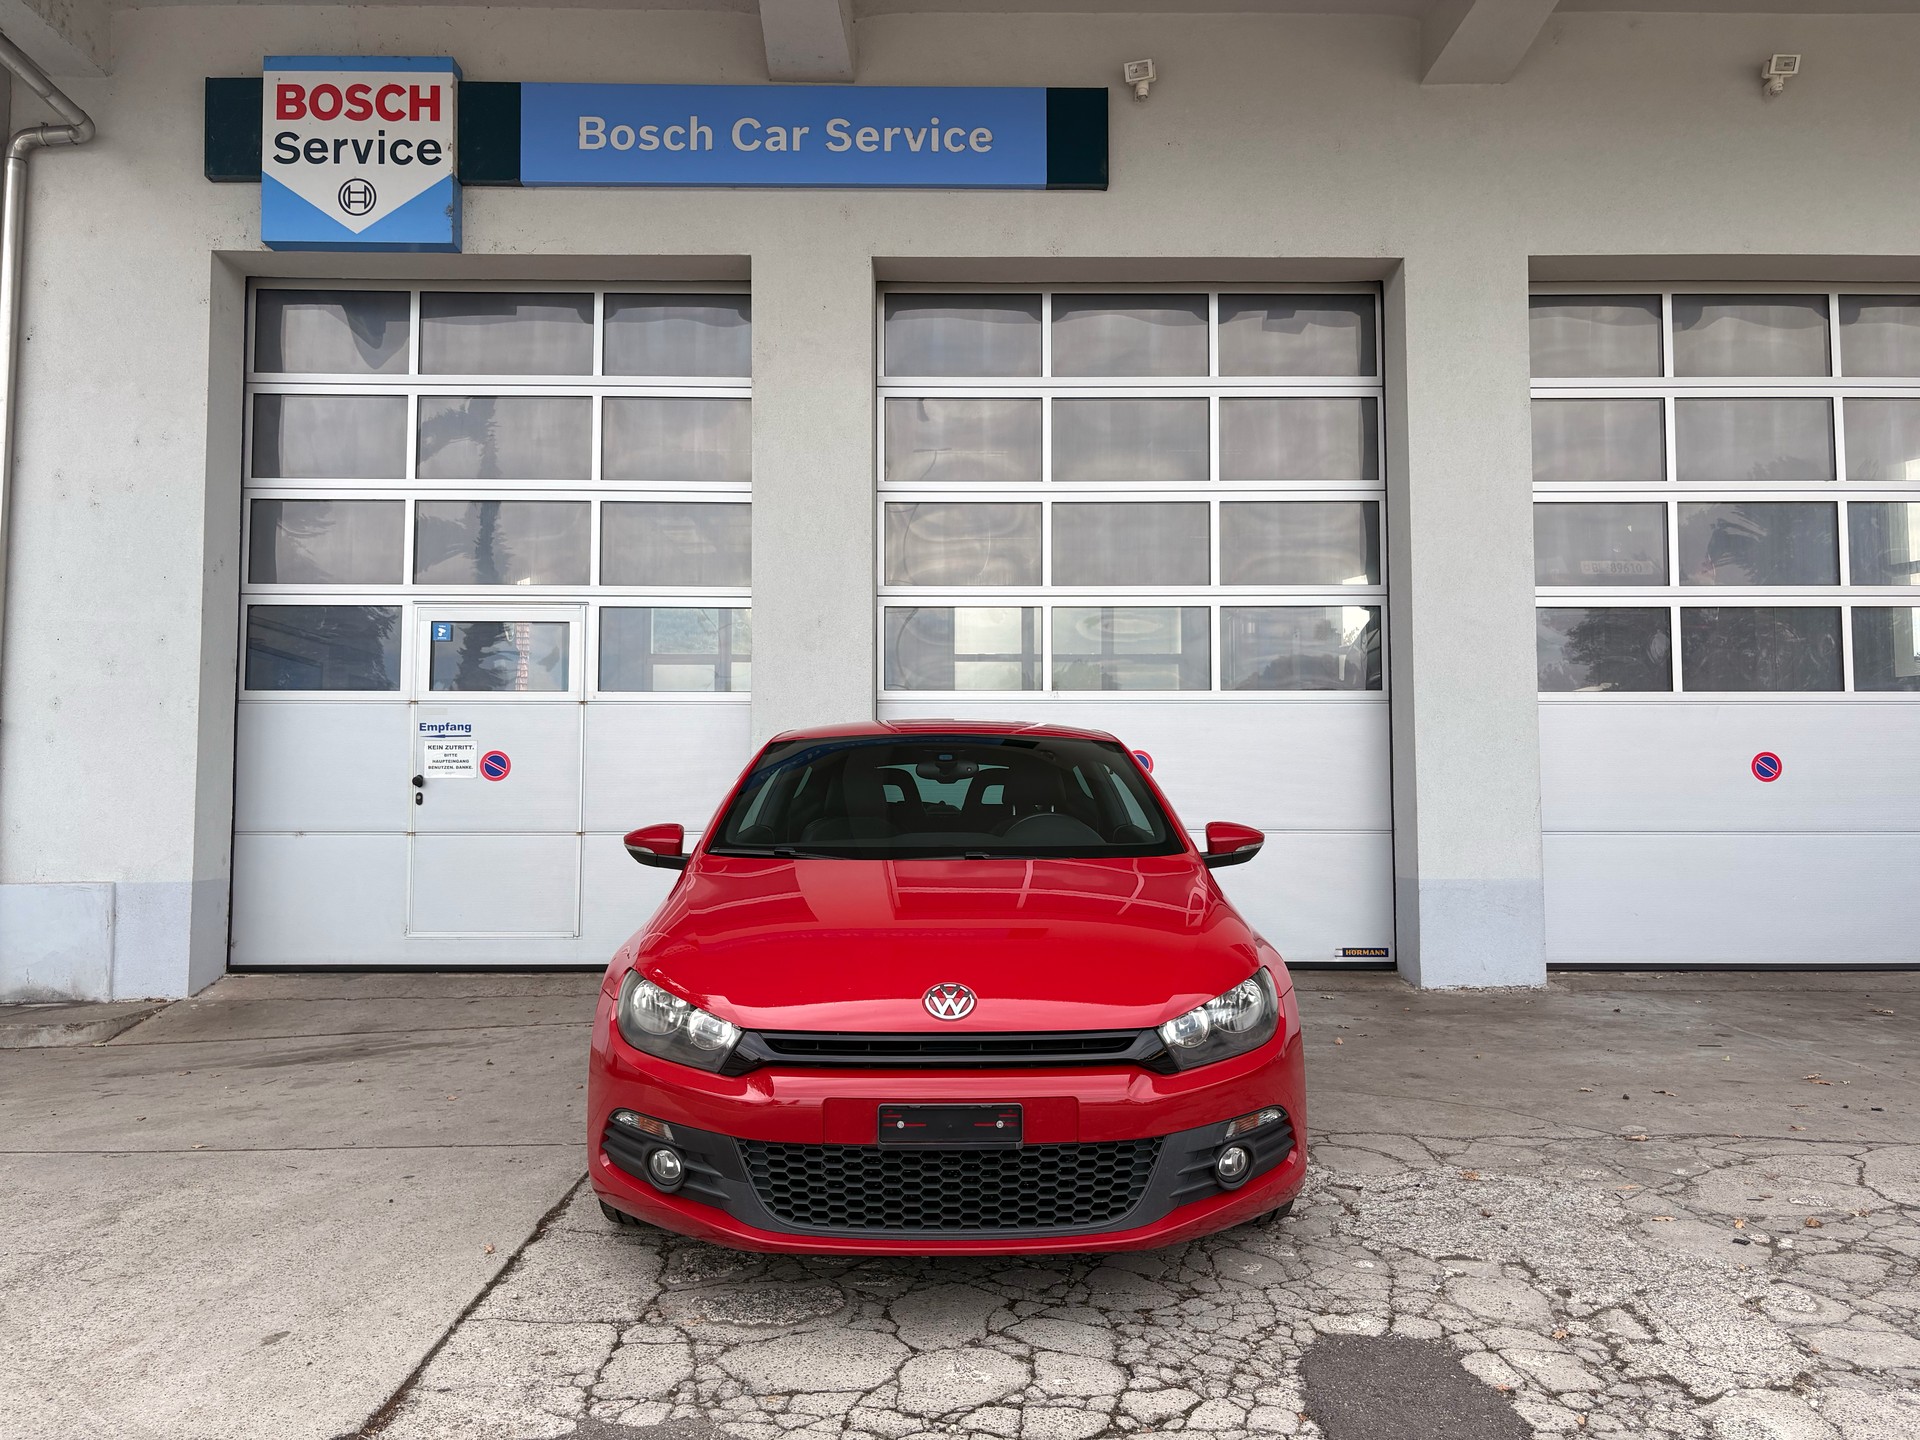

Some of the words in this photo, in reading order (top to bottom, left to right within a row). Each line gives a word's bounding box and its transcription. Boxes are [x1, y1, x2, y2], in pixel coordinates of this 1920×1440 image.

[276, 84, 440, 121] BOSCH
[273, 130, 442, 165] Service
[578, 115, 713, 151] Bosch
[731, 118, 809, 152] Car
[824, 118, 993, 153] Service
[419, 722, 472, 733] Empfang
